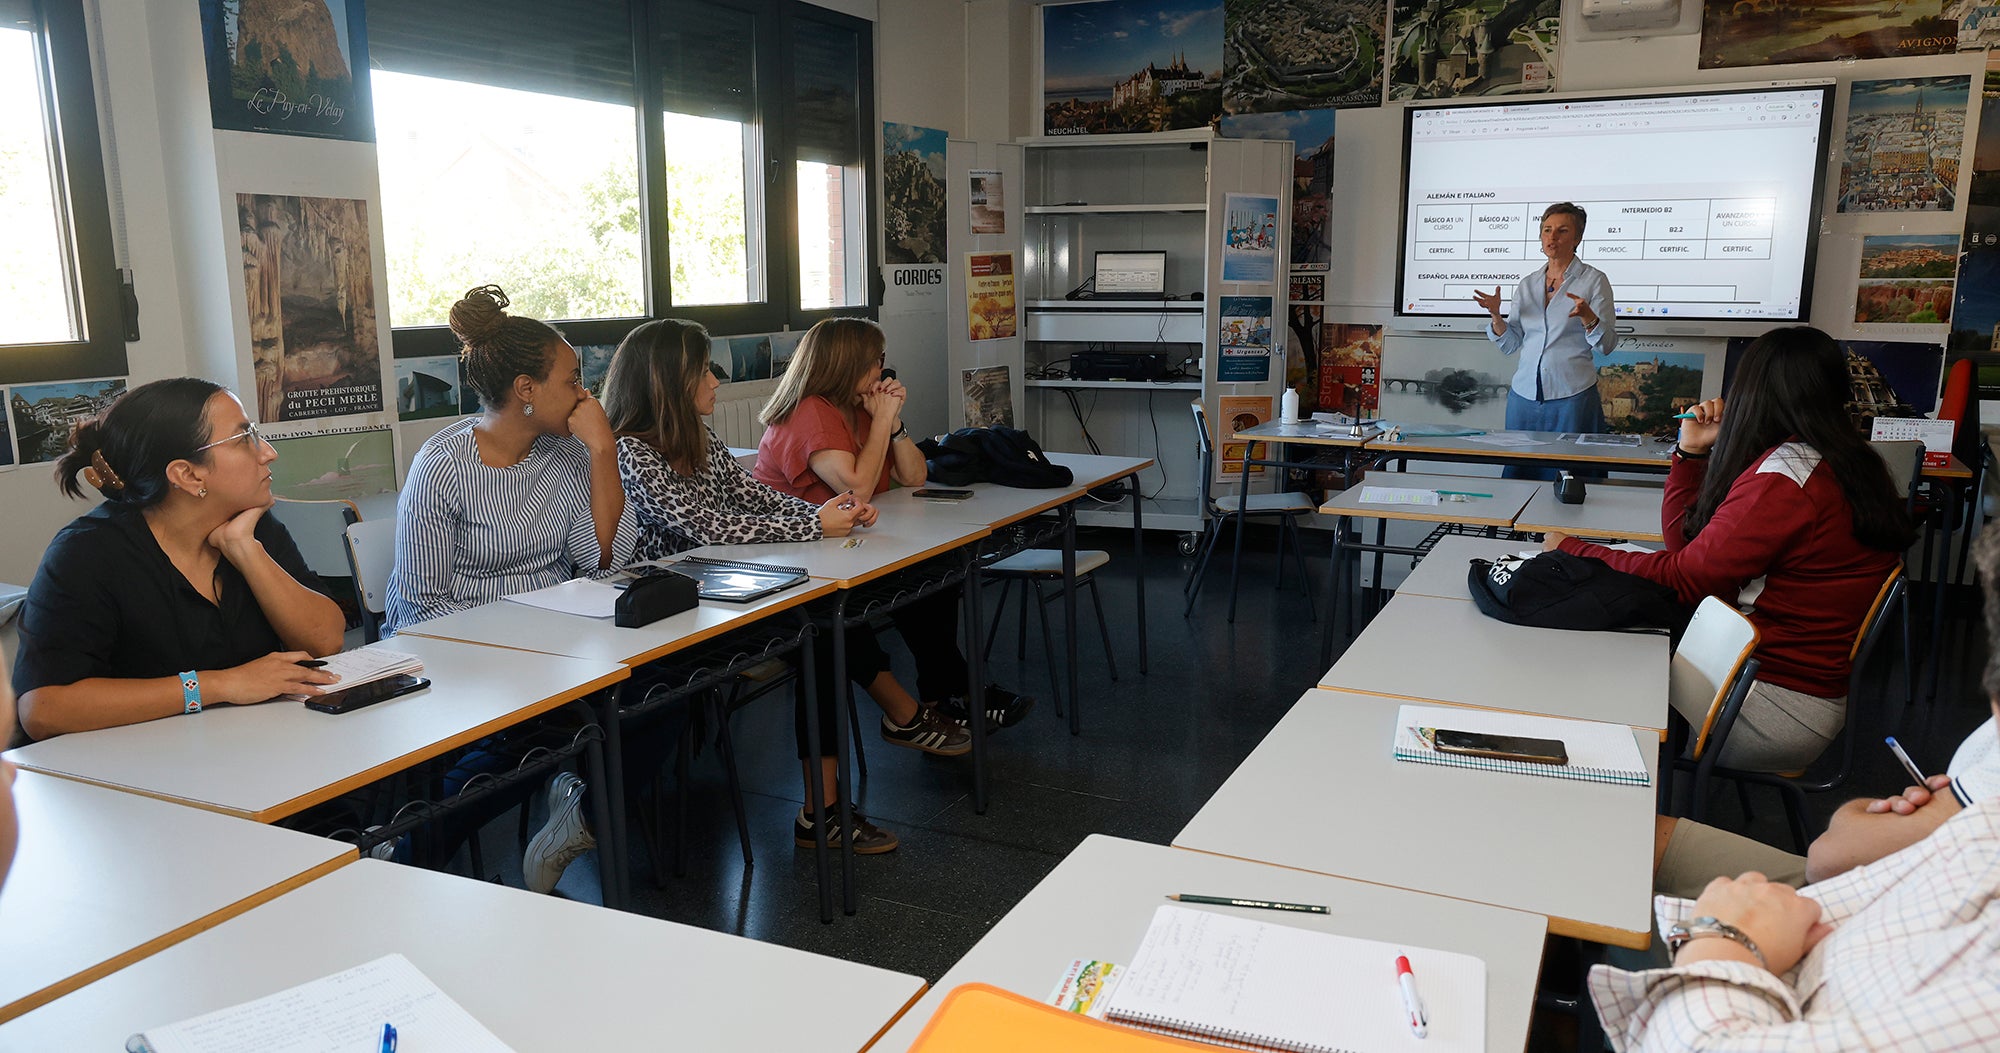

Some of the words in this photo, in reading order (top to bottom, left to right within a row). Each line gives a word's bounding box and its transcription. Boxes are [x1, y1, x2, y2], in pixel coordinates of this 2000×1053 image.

[1326, 93, 1380, 104] CARCASSONNE
[247, 87, 268, 115] Le
[267, 88, 345, 125] Puy-en-Velay
[1048, 125, 1089, 136] NEUCHÂTEL
[1426, 191, 1456, 200] ALEMÁN
[1463, 191, 1496, 199] ITALIANO
[1423, 215, 1445, 223] BÁSICO
[1478, 215, 1500, 223] BÁSICO
[894, 269, 942, 286] GORDES
[287, 388, 319, 399] GROTTE
[320, 384, 377, 396] PREHISTORIQUE
[288, 400, 301, 410] du
[305, 397, 336, 408] PECH
[340, 393, 378, 405] MERLE
[288, 408, 328, 417] CABRERETS
[354, 403, 379, 411] FRANCE
